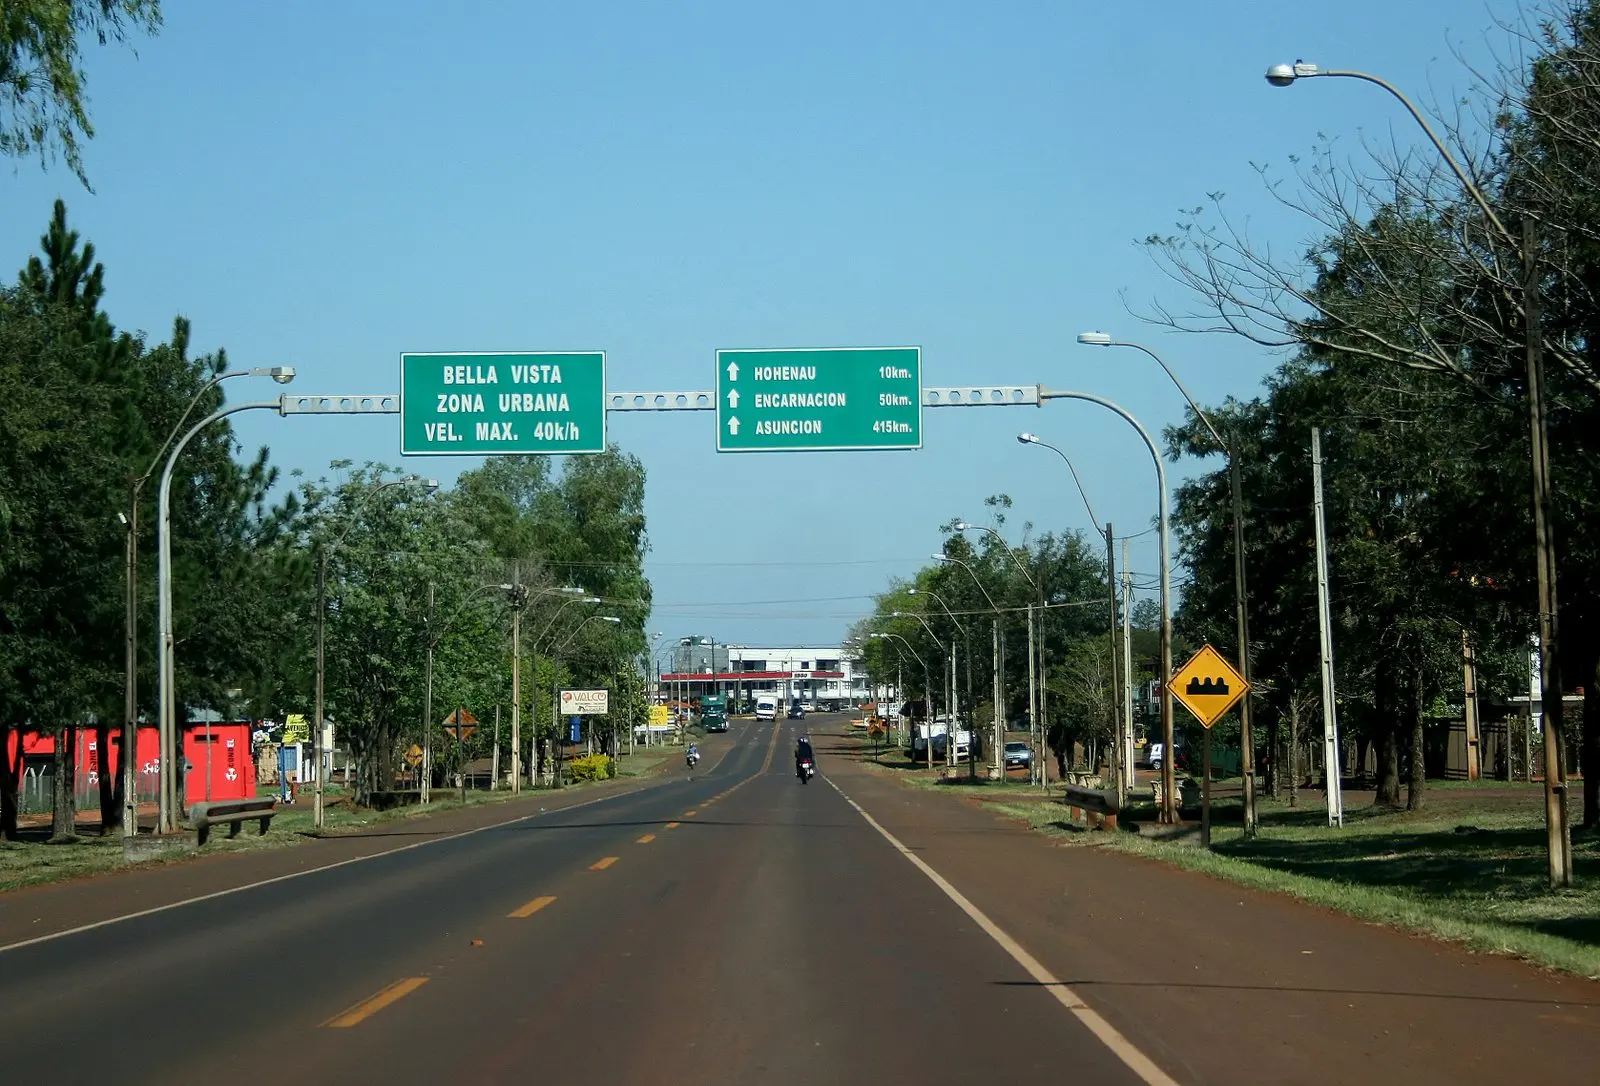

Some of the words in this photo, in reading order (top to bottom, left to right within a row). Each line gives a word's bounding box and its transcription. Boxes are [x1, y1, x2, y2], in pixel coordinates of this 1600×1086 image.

[444, 366, 497, 384] BELLA
[512, 365, 561, 383] VISTA
[755, 367, 815, 380] HOHENAU
[880, 367, 911, 378] 10km.
[437, 394, 484, 412] ZONA
[499, 394, 569, 412] URBANA
[755, 393, 845, 407] ENCARNACION
[880, 394, 911, 405] 50km.
[425, 423, 462, 441] VEL.
[476, 423, 517, 440] MAX.
[534, 422, 579, 440] 40k/h
[756, 420, 821, 434] ASUNCION
[873, 421, 912, 432] 415km.
[573, 692, 606, 701] VALCO
